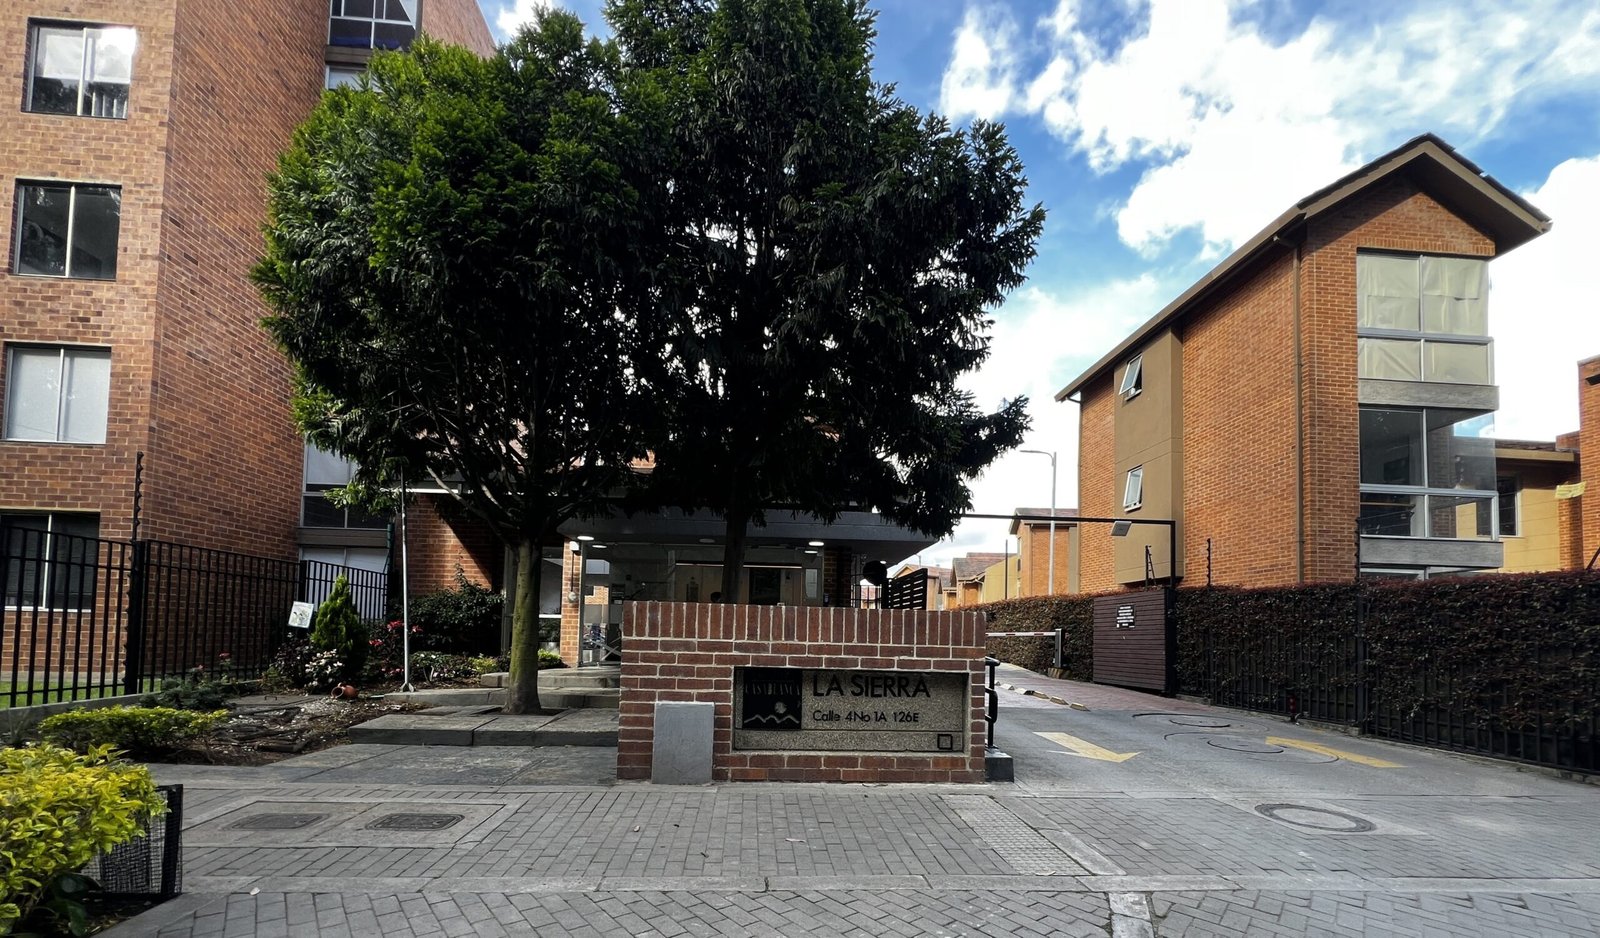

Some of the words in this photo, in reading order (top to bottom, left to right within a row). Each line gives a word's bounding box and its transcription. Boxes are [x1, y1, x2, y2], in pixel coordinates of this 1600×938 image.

[813, 673, 844, 696] LA
[850, 674, 930, 697] SIERRA
[812, 710, 841, 722] Calle
[893, 712, 919, 722] 126E
